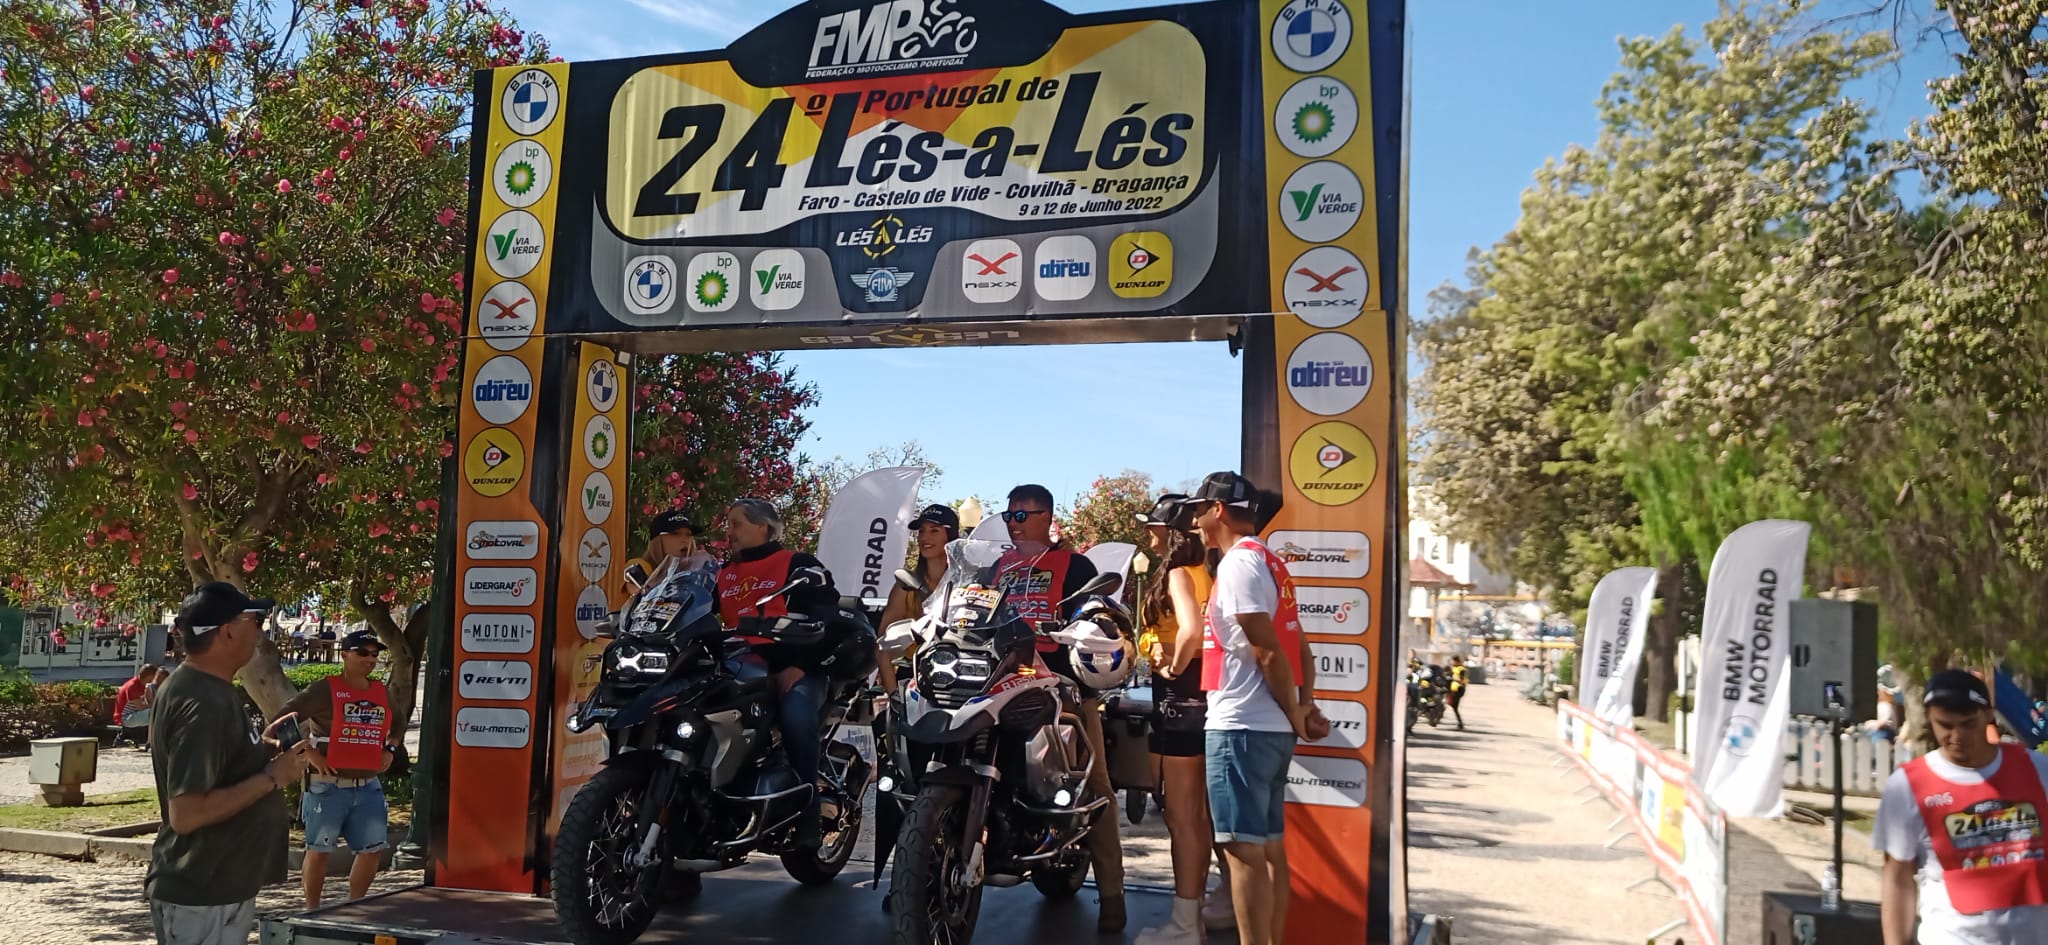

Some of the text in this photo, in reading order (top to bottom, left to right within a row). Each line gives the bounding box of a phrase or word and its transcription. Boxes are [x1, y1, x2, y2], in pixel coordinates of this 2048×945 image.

[1282, 0, 1342, 22] BMW
[809, 0, 924, 67] FMP
[805, 58, 965, 78] FEDERAÇÃO MOTOCICLISMO PORTUGAL
[509, 72, 553, 91] BMW
[863, 76, 1060, 113] Portugal de
[1319, 84, 1339, 99] bp
[804, 71, 1194, 189] Lés-a-Lés
[525, 147, 539, 160] bp
[798, 196, 840, 211] Faro
[853, 189, 921, 208] Castelo
[923, 187, 946, 204] de
[951, 185, 990, 202] Vide
[1006, 179, 1076, 199] Covilhã
[1091, 174, 1189, 194] Bragança
[1322, 193, 1342, 203] VIA
[1018, 196, 1163, 216] 9 a 12 de Junho 2022
[1318, 202, 1358, 214] VERDE
[515, 237, 530, 246] VIA
[511, 245, 540, 255] VERDE
[635, 263, 667, 277] BMW
[717, 256, 733, 270] bp
[1039, 258, 1091, 279] abreu
[778, 273, 792, 281] VIA
[775, 281, 803, 290] VERDE
[871, 278, 893, 293] FIM
[1115, 280, 1166, 290] DUNLOP
[591, 362, 616, 378] BMW
[1291, 361, 1368, 388] abreu
[475, 380, 530, 402] abreu
[602, 422, 611, 433] bp
[472, 477, 516, 485] DUNLOP
[1302, 482, 1364, 490] DUNLOP
[469, 581, 516, 591] LIDERGRAF
[472, 624, 524, 640] MOTONI
[1748, 567, 1779, 706] MOTORRAD
[1597, 638, 1613, 678] BMW
[1723, 638, 1746, 702] BMW
[469, 725, 526, 735] SW-MOTECH
